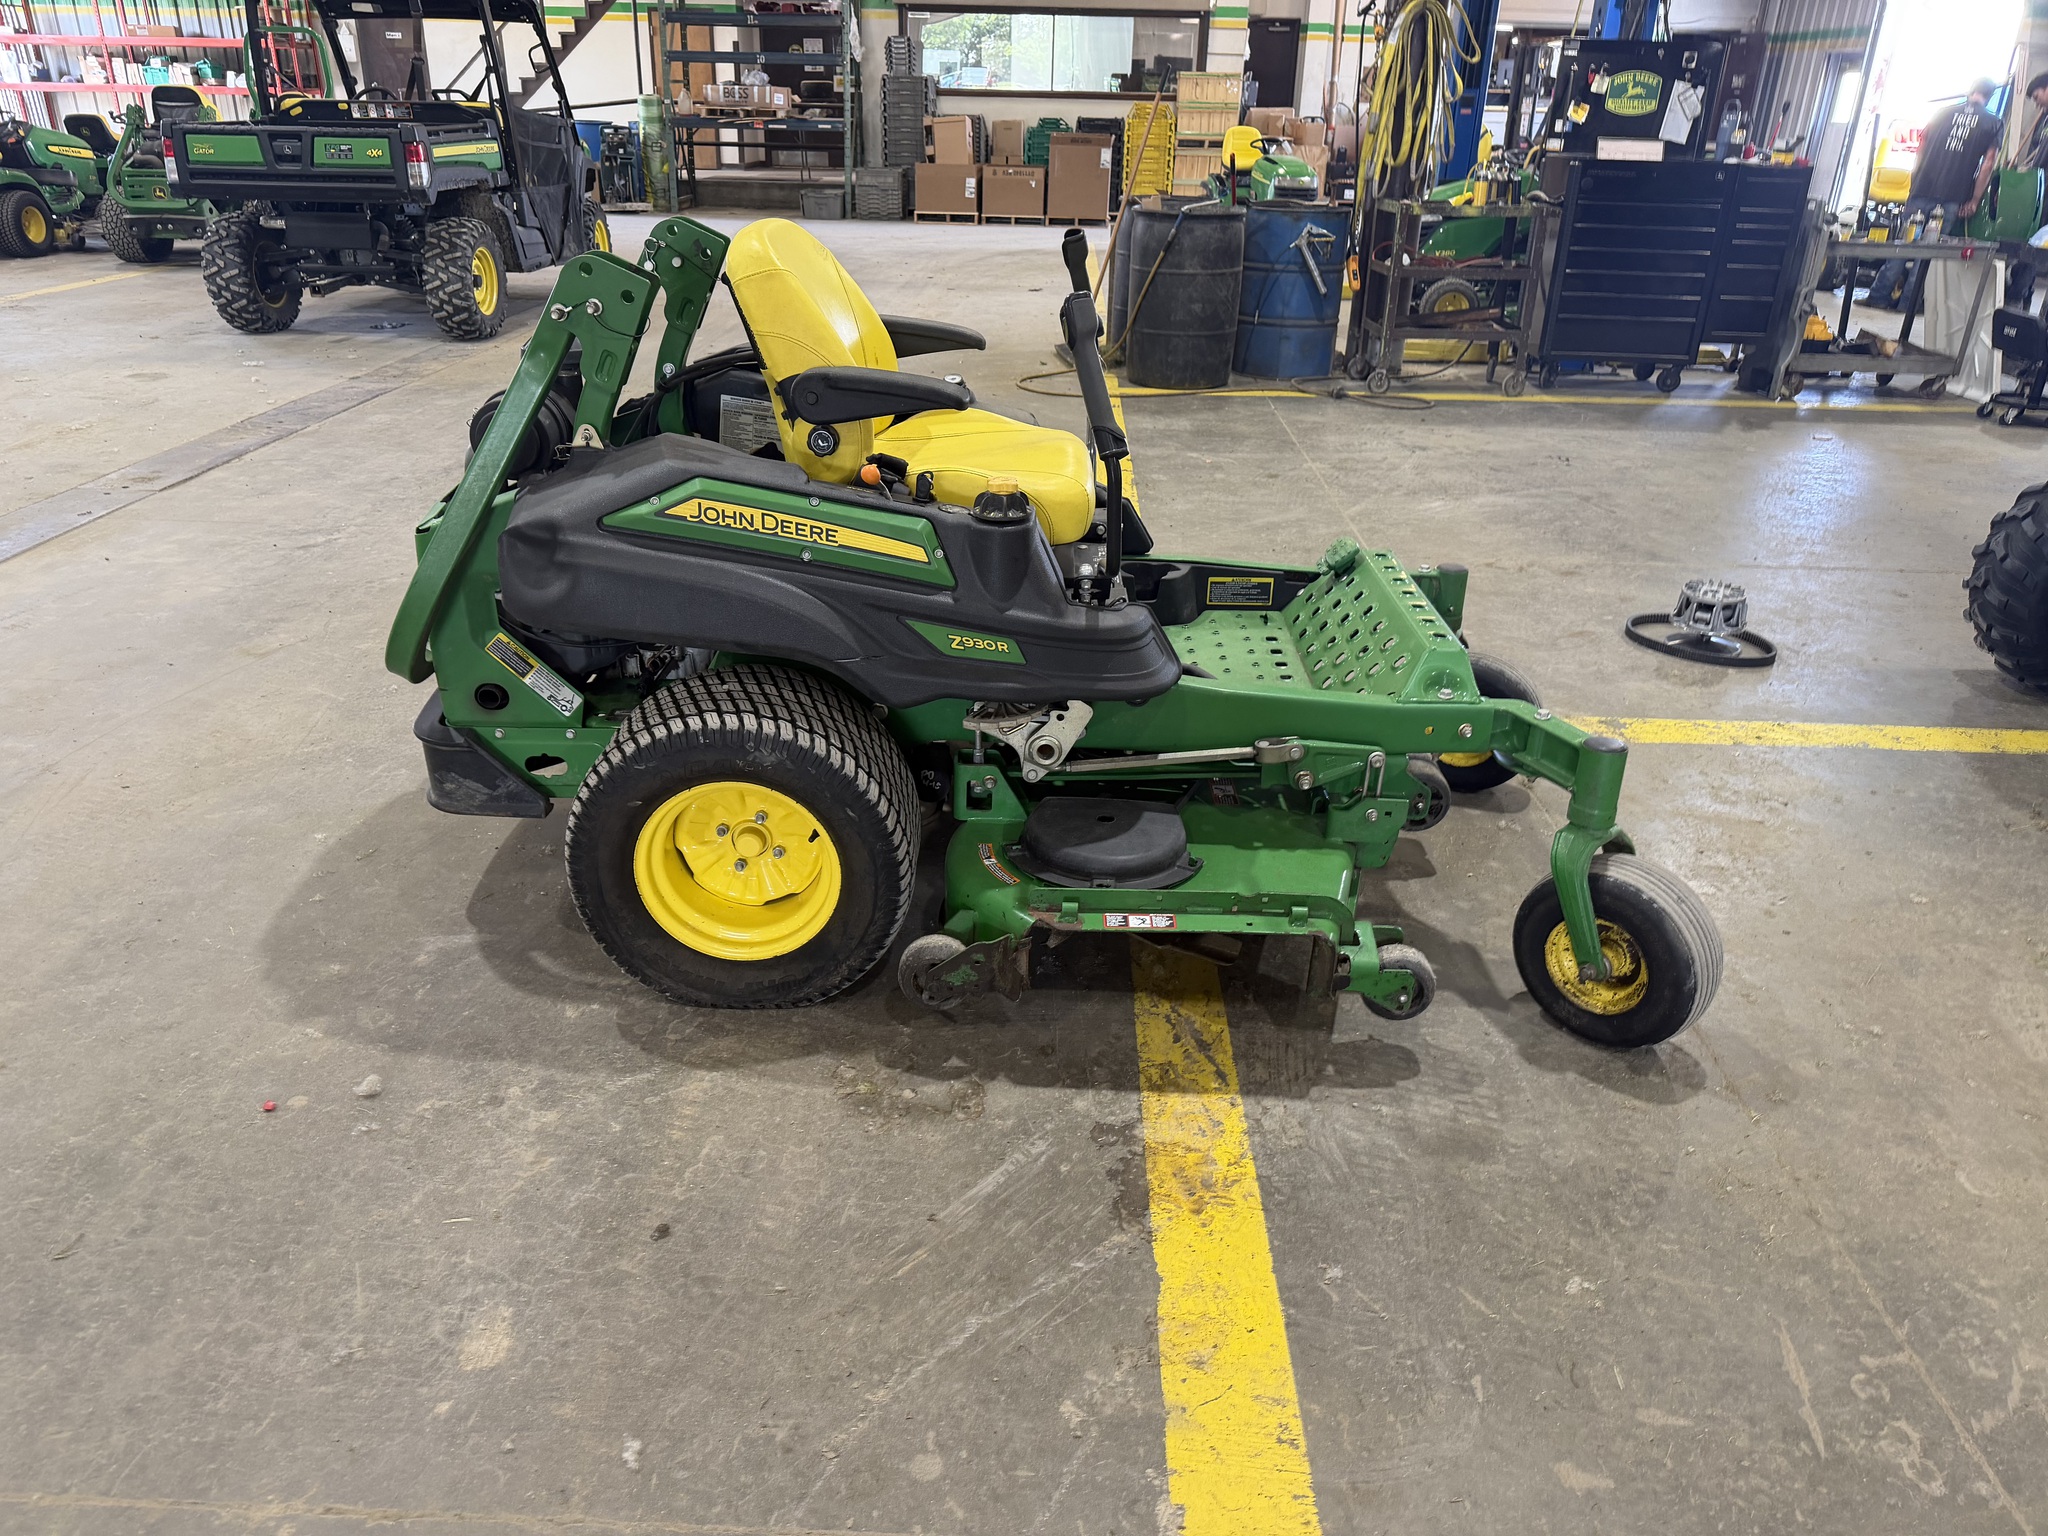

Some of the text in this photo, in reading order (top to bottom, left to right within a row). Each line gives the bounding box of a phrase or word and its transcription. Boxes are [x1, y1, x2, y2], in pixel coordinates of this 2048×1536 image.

[1614, 73, 1658, 87] JOHN DEERE
[723, 87, 749, 99] BOSS
[1949, 124, 1970, 140] AND
[193, 147, 215, 155] GATOR
[689, 501, 839, 544] JOHN DEERE
[947, 634, 1010, 653] Z930R
